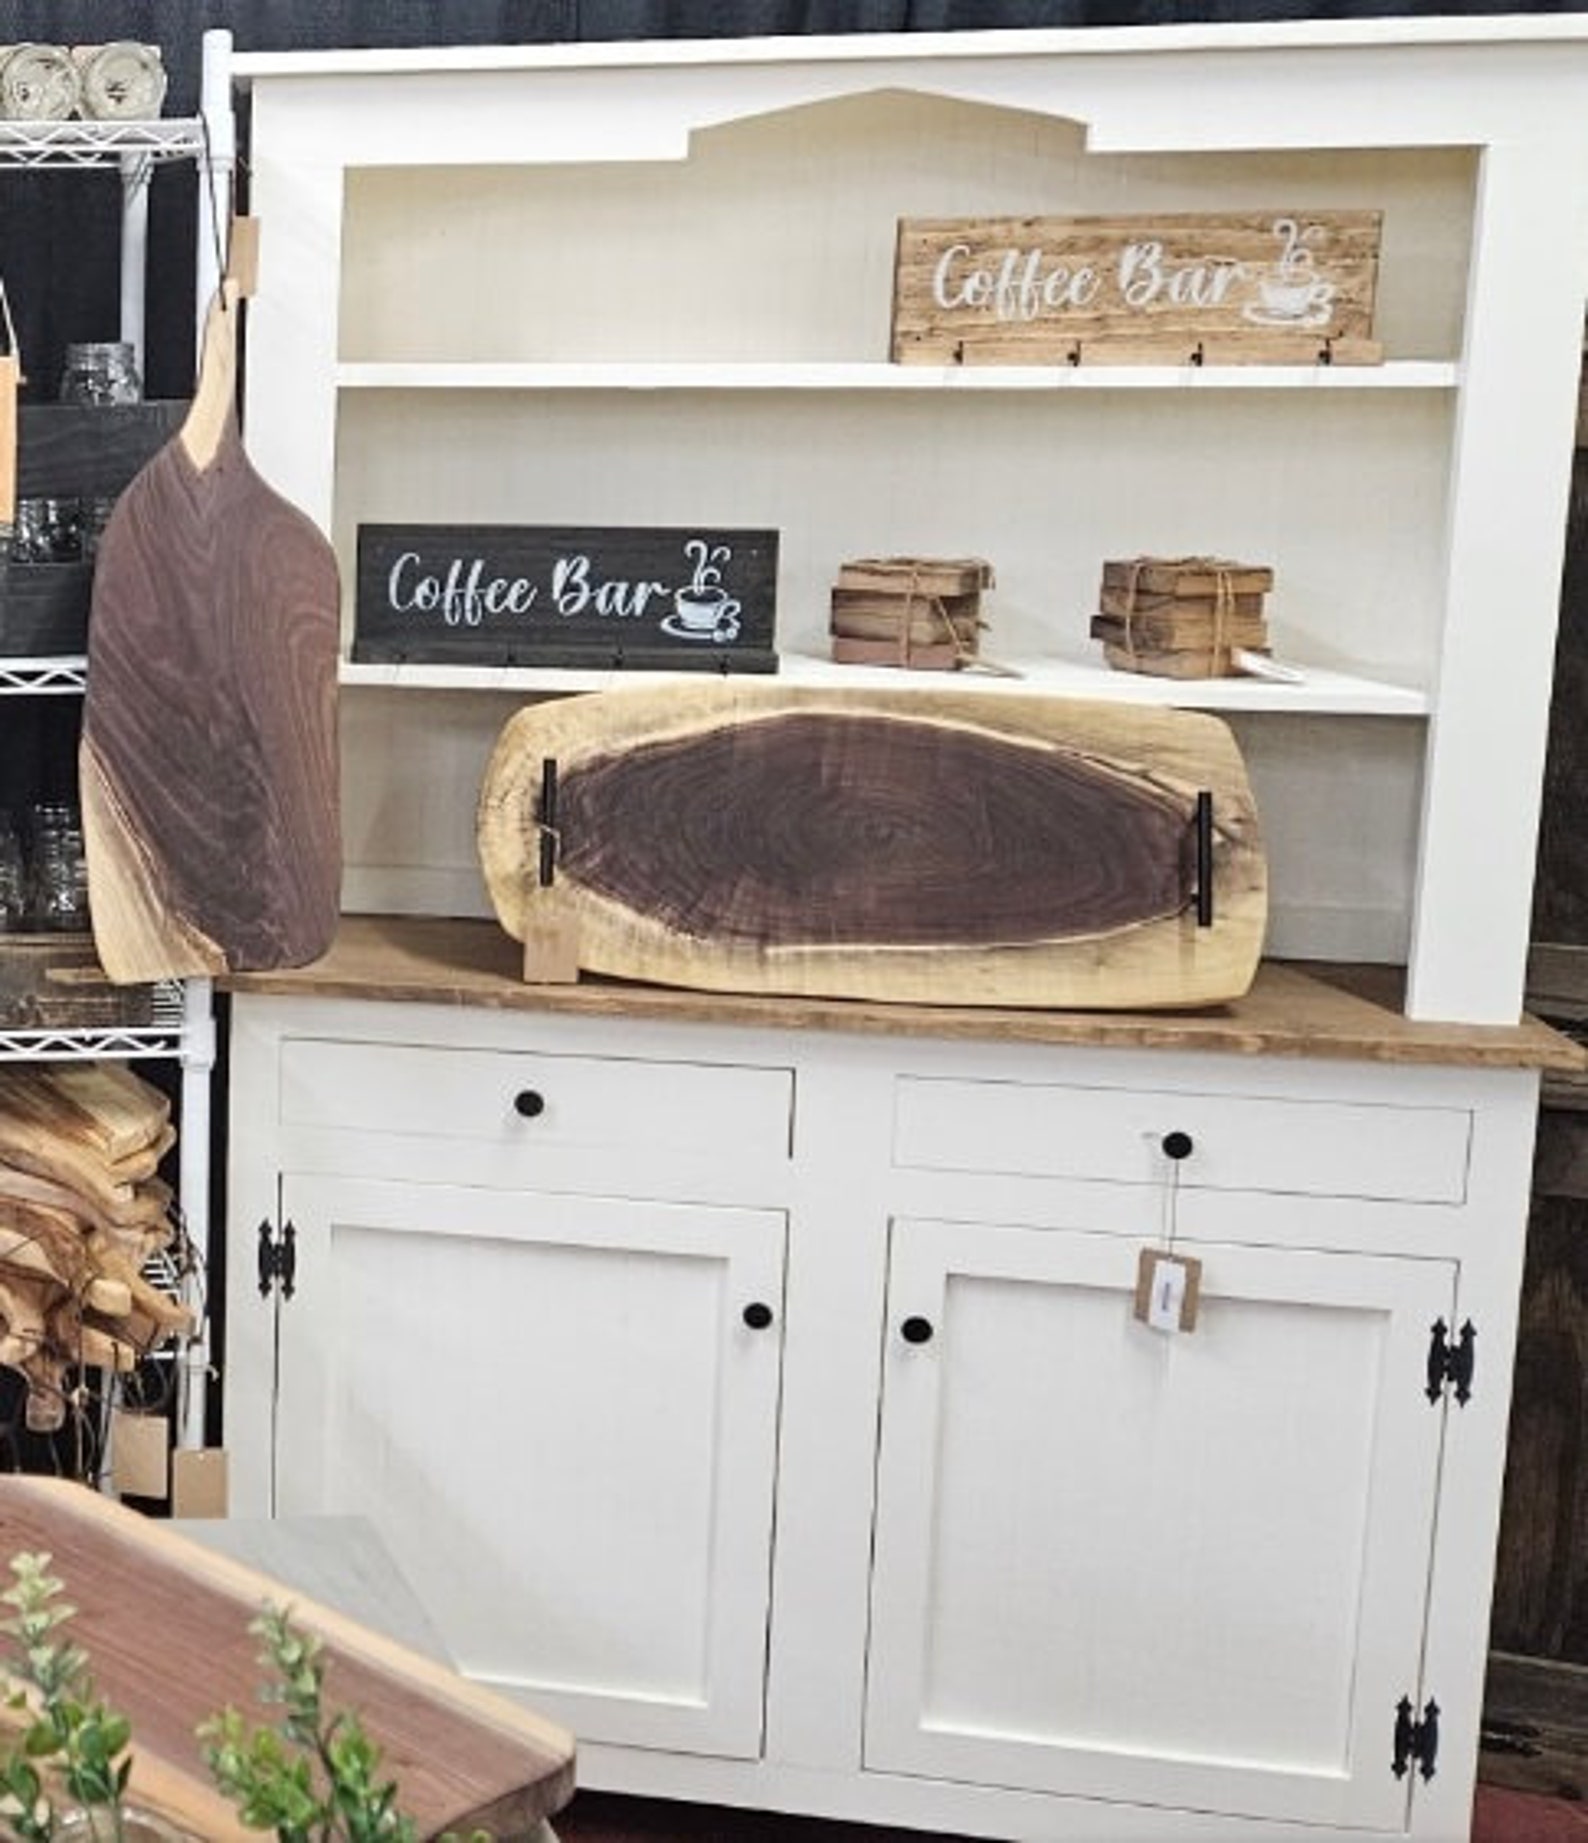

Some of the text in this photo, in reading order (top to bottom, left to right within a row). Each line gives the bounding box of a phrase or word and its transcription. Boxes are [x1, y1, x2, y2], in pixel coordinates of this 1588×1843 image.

[933, 240, 1244, 322] Coffee Bar
[388, 552, 670, 626] Coffee Bar
